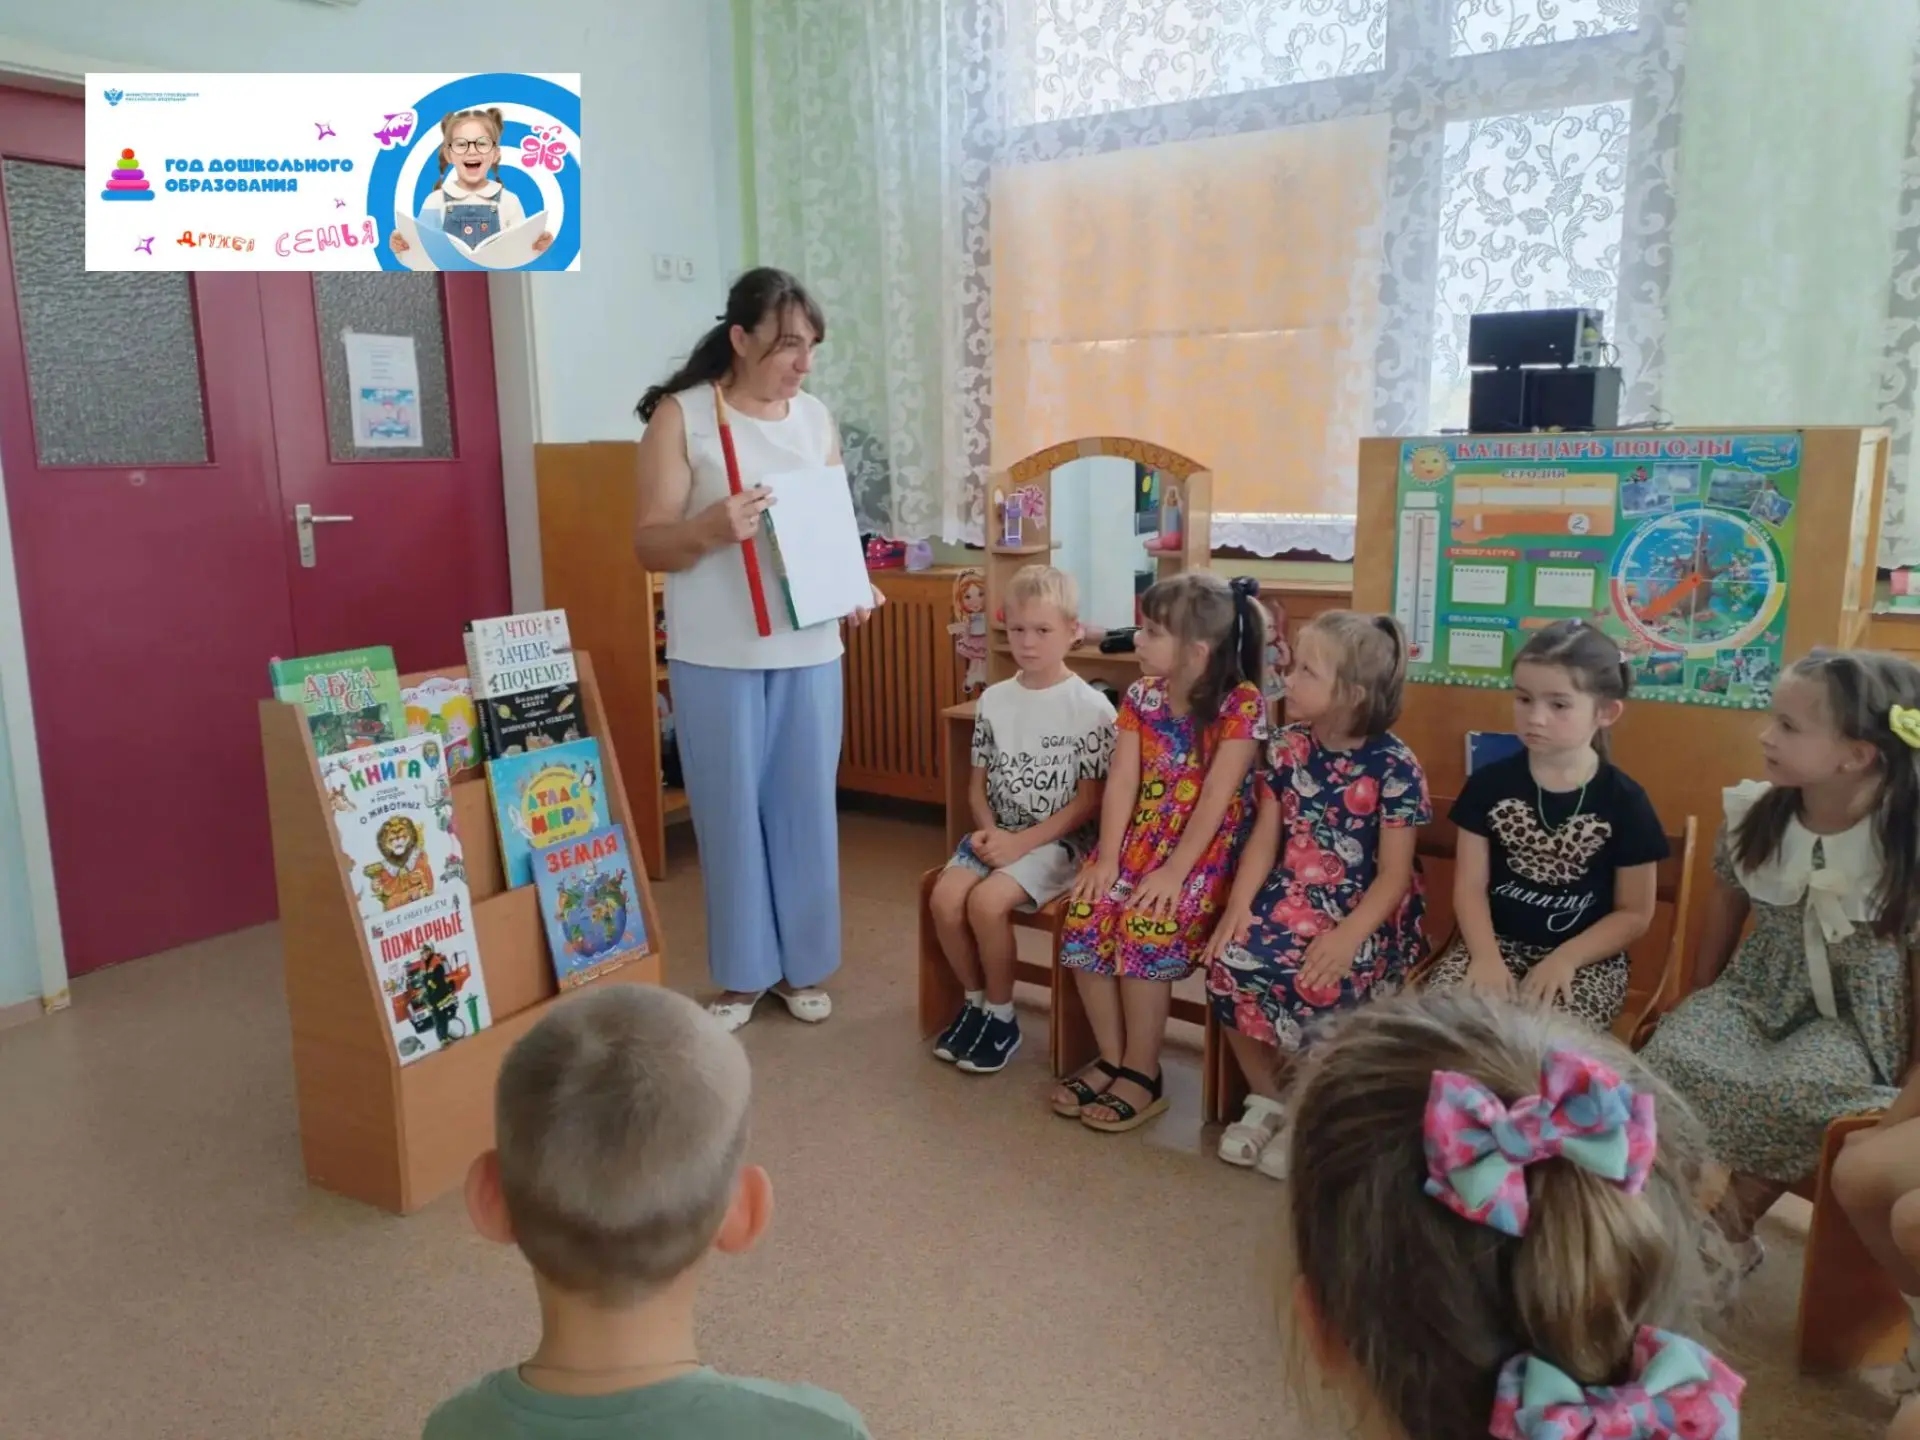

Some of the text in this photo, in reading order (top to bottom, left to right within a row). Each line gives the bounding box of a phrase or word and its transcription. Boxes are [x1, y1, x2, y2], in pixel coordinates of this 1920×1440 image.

[1455, 441, 1606, 461] КАЛЕНДАРЬ
[1612, 438, 1734, 459] ПОГОДЫ
[500, 661, 571, 691] ПОЧЕМУ?
[350, 759, 421, 791] КНИГА
[528, 782, 582, 812] АТЛАС
[531, 804, 588, 835] МИРА
[545, 832, 618, 874] ЗЕМЛЯ
[381, 911, 464, 963] ПОЖАРНЫЕ
